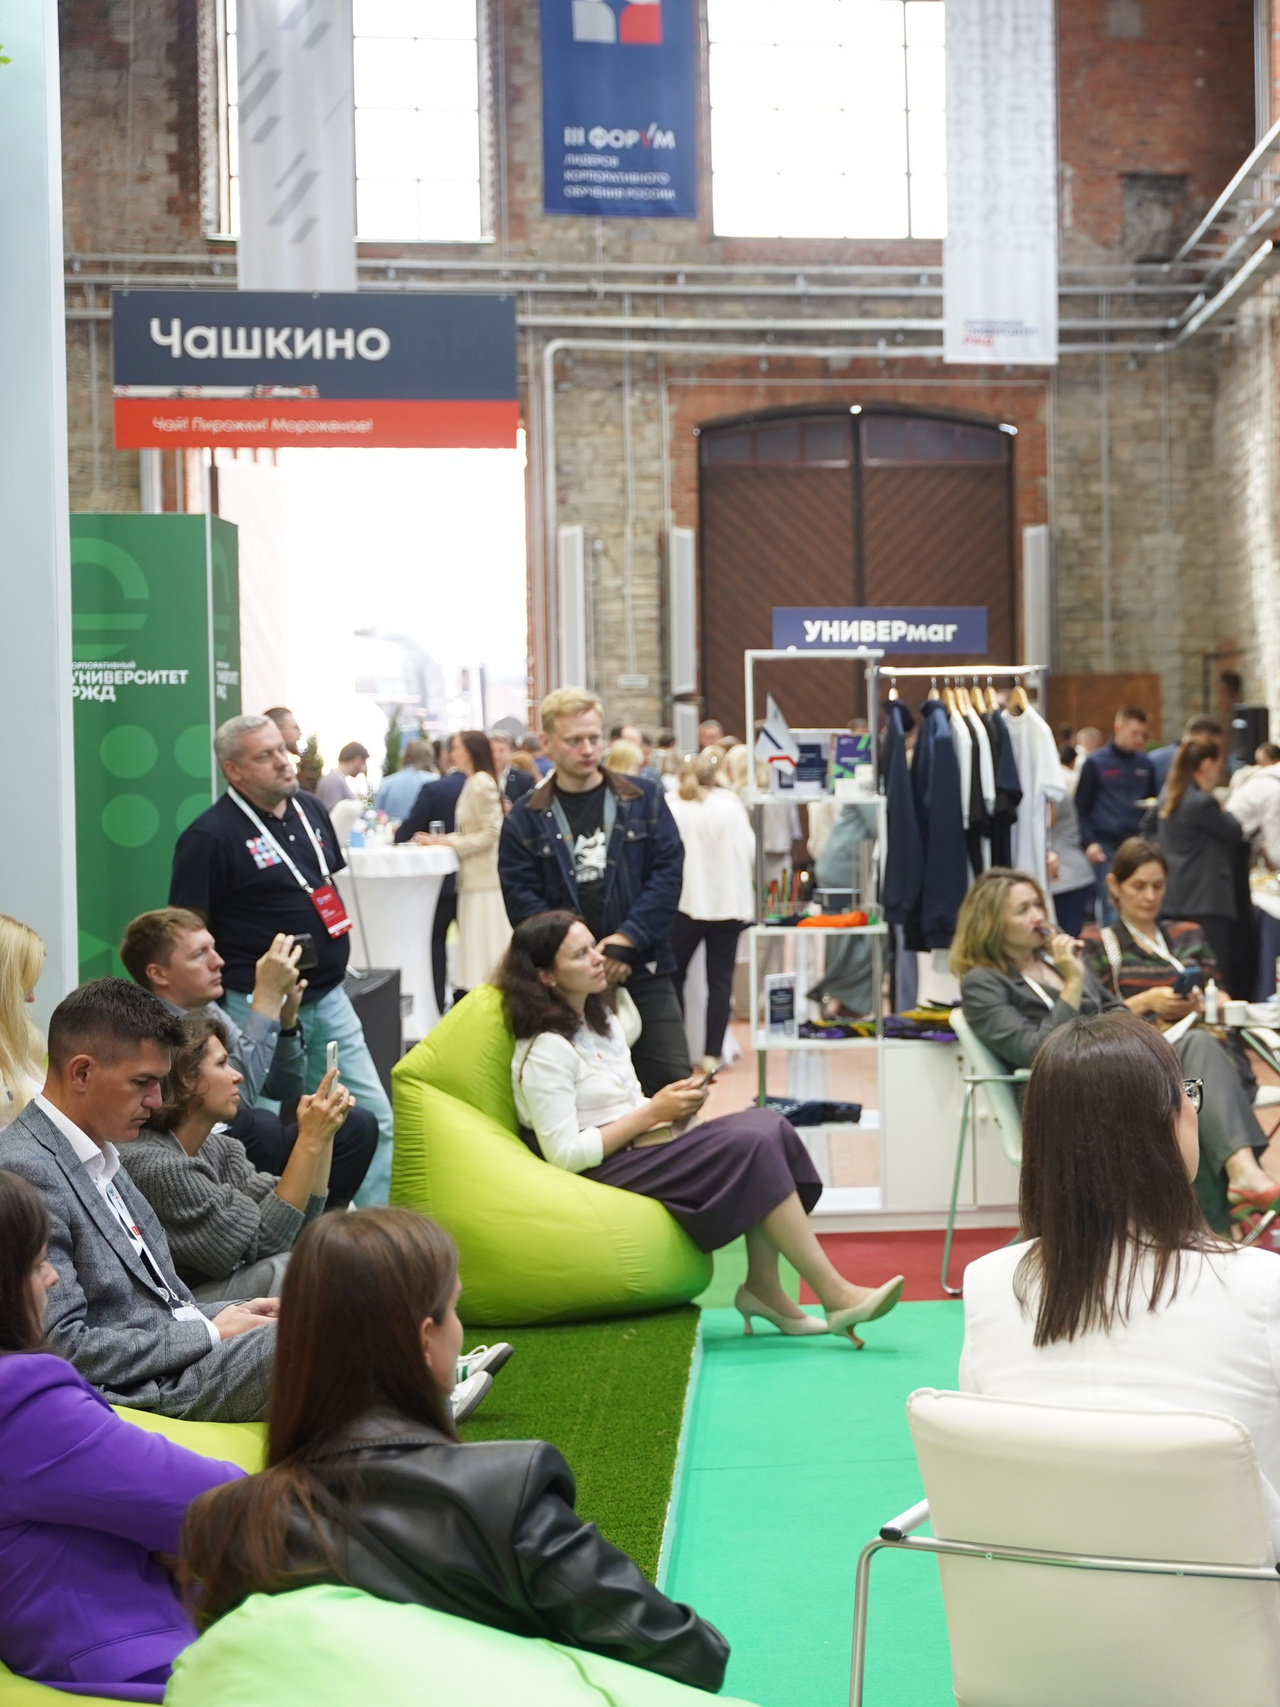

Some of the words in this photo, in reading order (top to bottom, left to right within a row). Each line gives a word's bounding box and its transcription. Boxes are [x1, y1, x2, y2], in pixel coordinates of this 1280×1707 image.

[564, 126, 585, 147] III
[150, 317, 391, 361] Чашкино
[191, 417, 269, 435] Пирожки!
[803, 620, 958, 642] УНИВЕРмаг
[72, 660, 136, 670] ОРПОРАТИВНЫЙ
